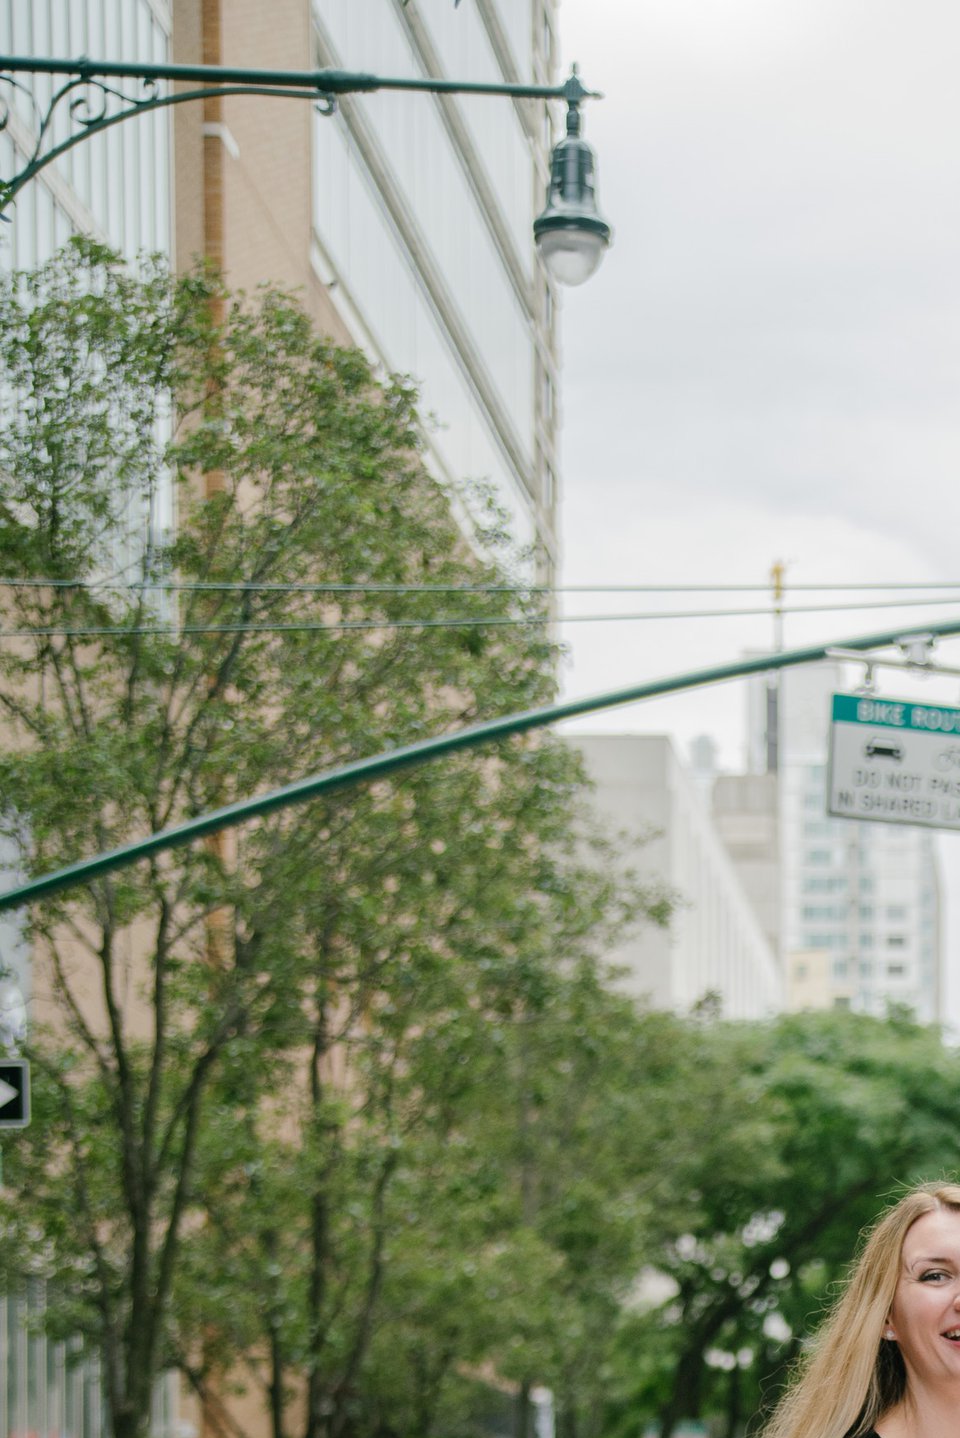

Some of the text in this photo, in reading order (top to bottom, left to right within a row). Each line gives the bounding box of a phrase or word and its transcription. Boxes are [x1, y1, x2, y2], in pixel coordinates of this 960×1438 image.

[857, 699, 905, 726] BIKE
[853, 767, 881, 789] DO
[885, 772, 921, 792] NOT
[860, 792, 937, 818] SHARED
